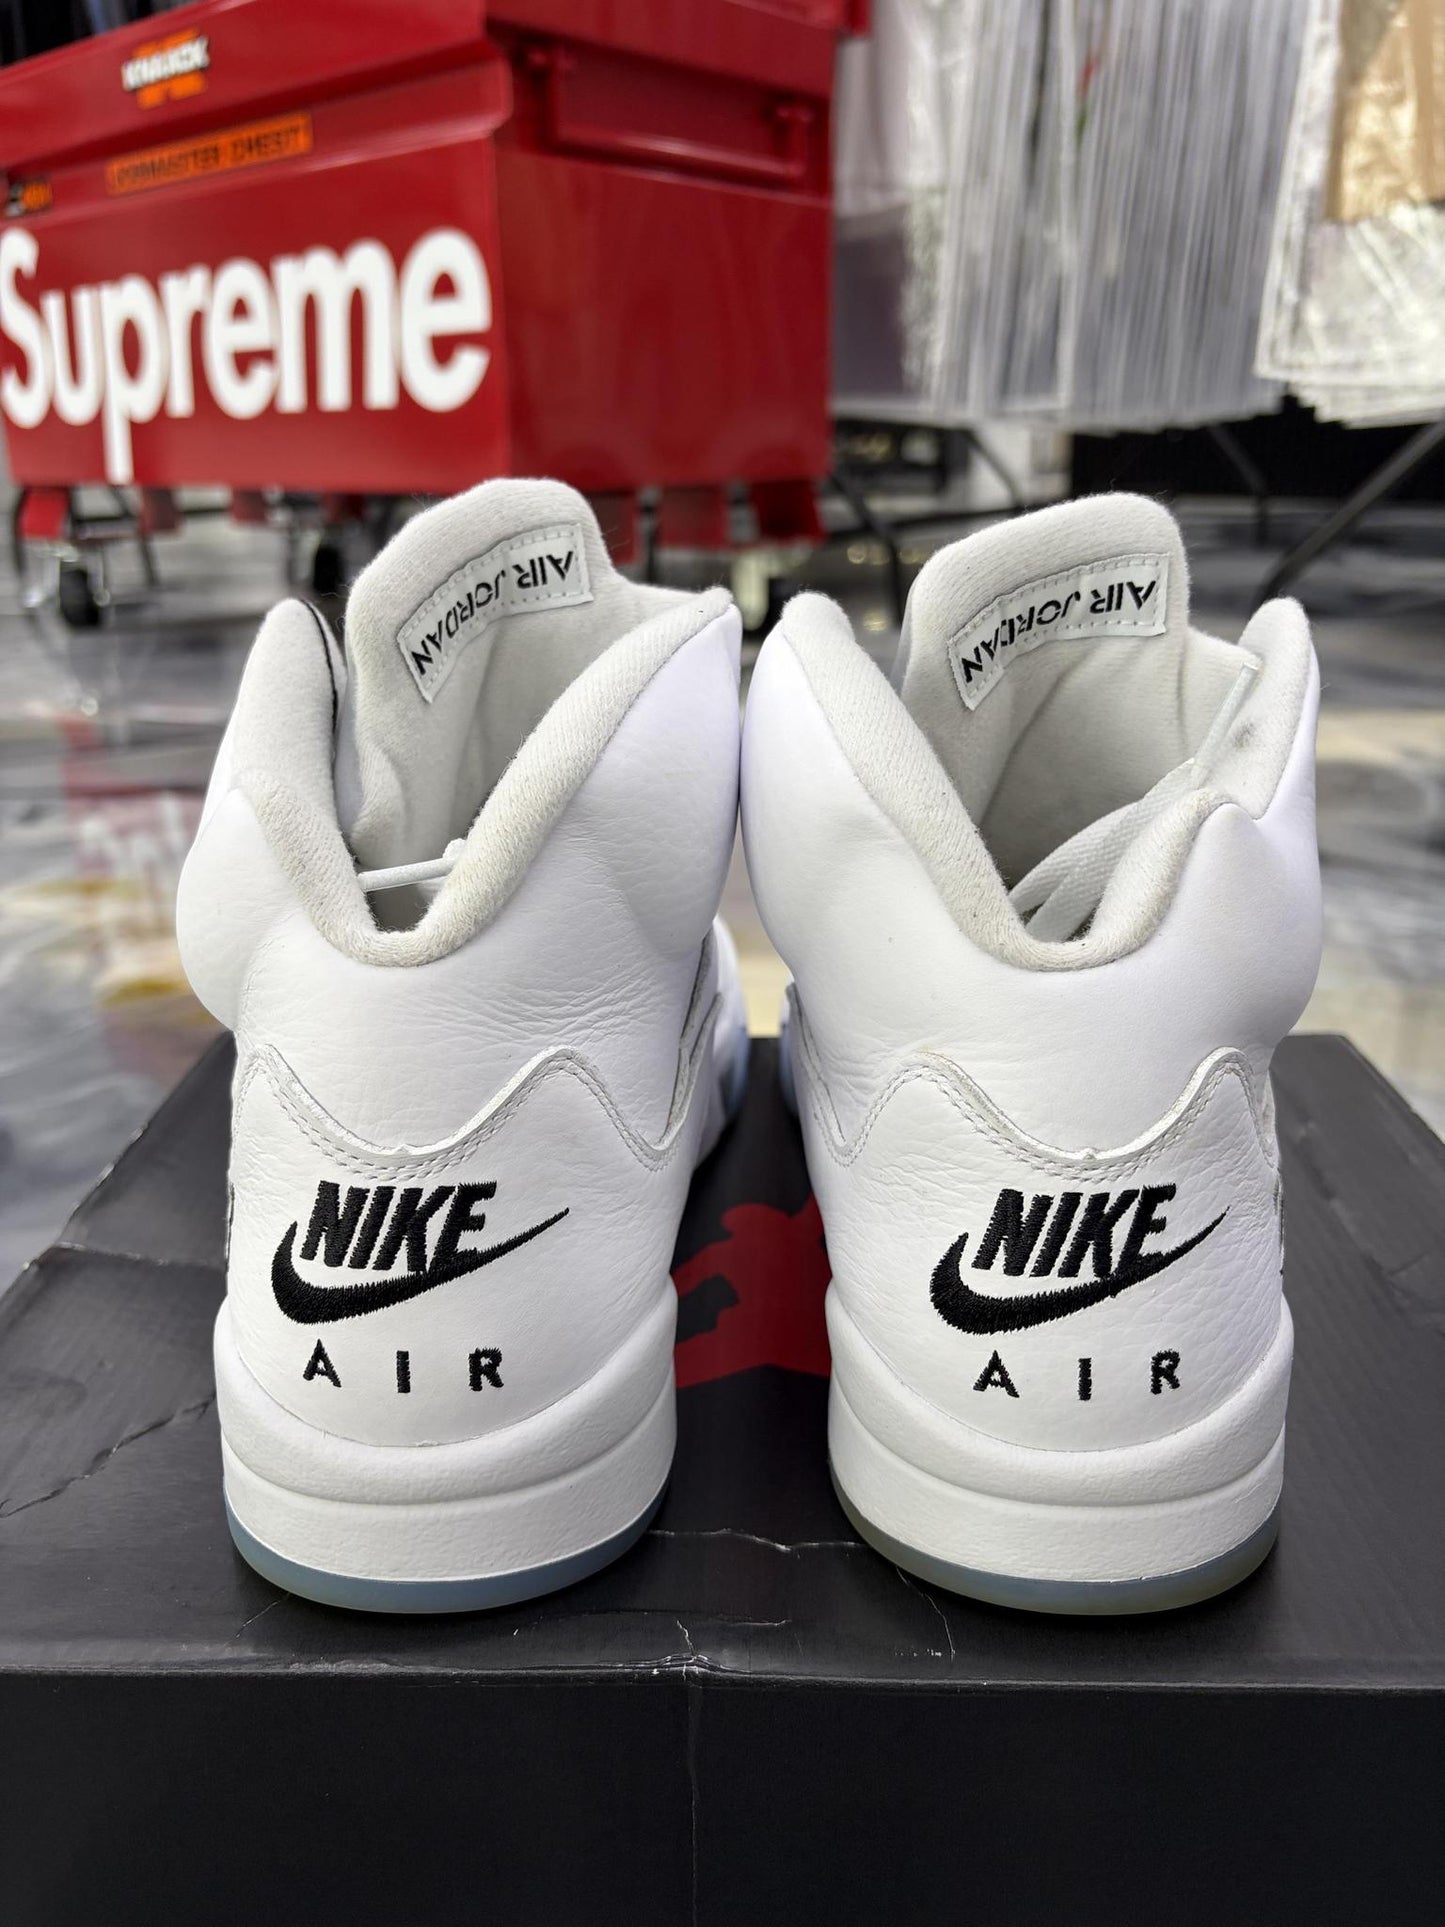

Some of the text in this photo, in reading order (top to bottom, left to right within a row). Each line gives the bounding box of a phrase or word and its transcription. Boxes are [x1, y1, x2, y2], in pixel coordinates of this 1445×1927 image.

[0, 227, 491, 486] Supreme
[410, 551, 574, 676] AIR JORDAN
[960, 580, 1157, 684] AIR JORDAN
[299, 1179, 498, 1272] NIKE
[970, 1182, 1178, 1279] NIKE
[302, 1338, 504, 1394] AIR
[972, 1349, 1181, 1401] AIR
